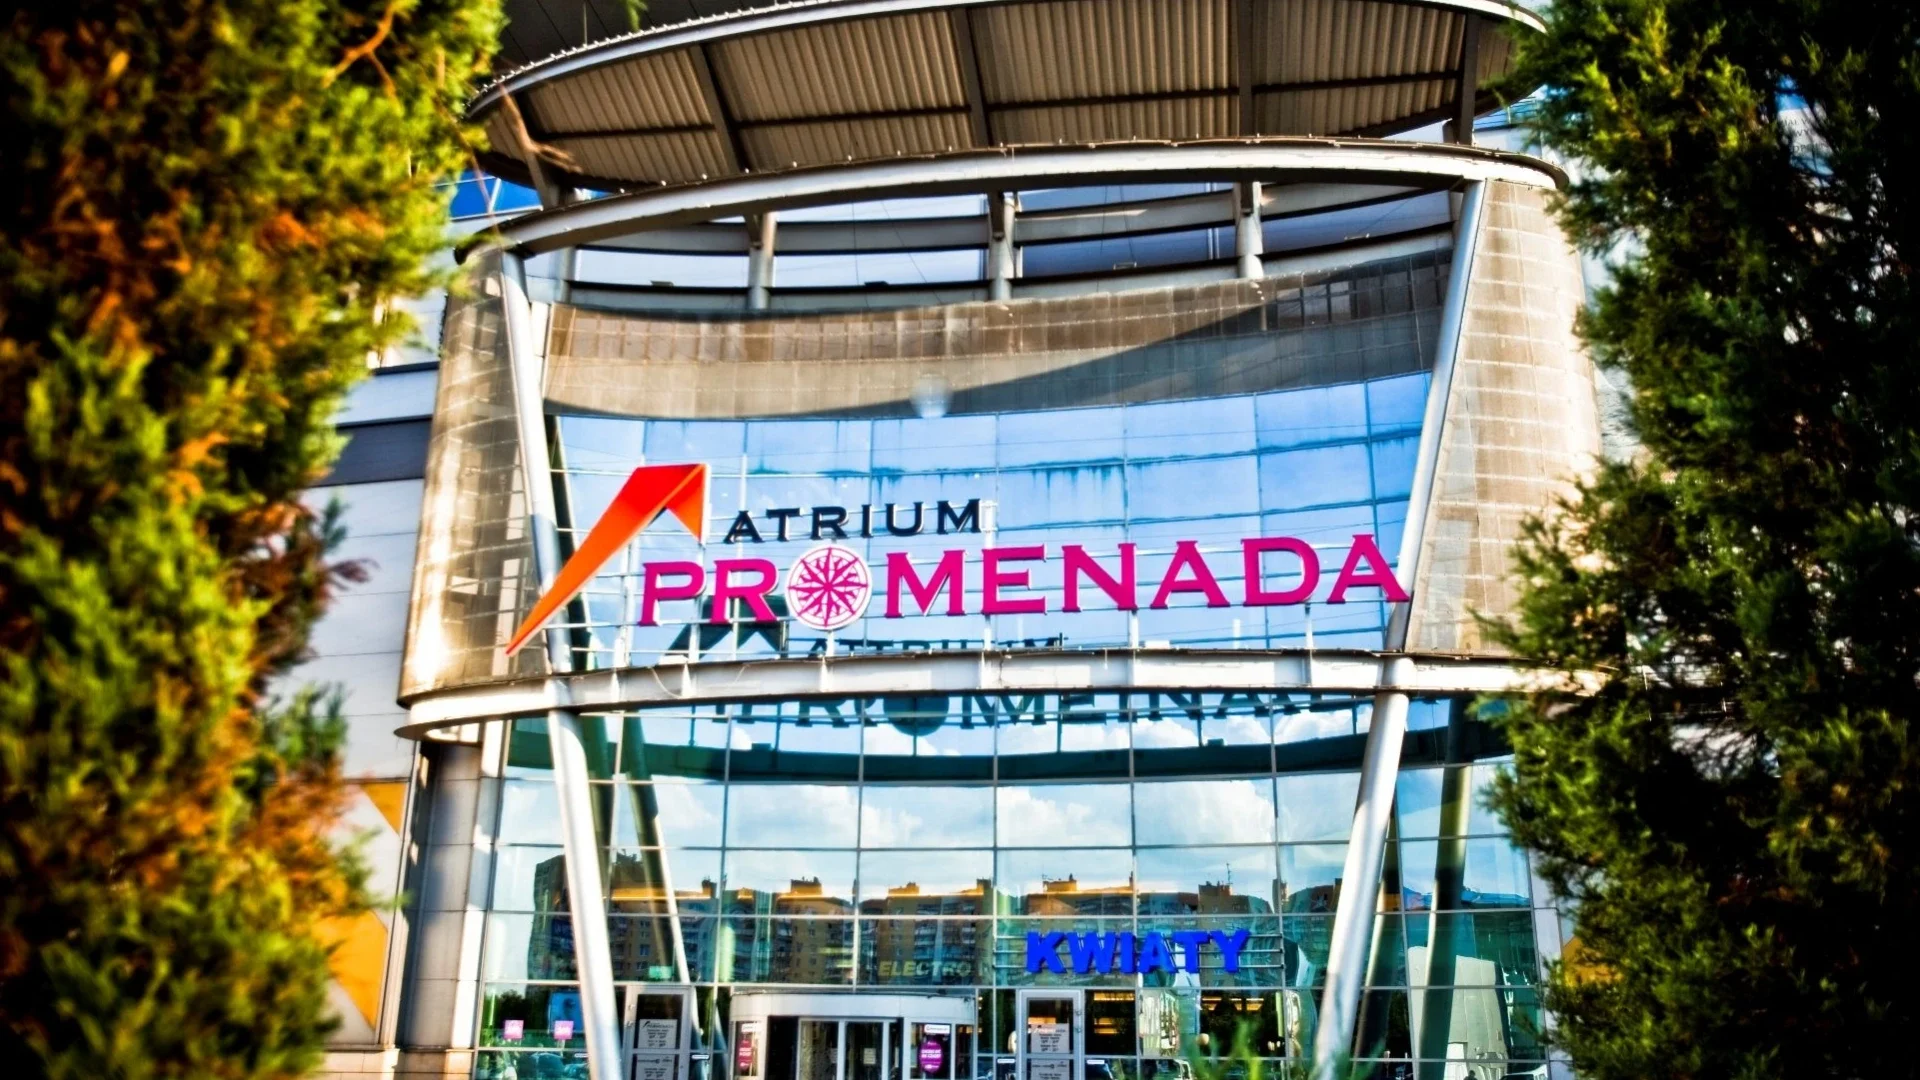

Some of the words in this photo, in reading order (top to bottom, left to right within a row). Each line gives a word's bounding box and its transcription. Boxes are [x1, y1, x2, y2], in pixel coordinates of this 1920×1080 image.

[723, 498, 983, 543] ATRIUM
[637, 534, 1410, 630] PROMENADA
[1025, 929, 1250, 974] KWIATY
